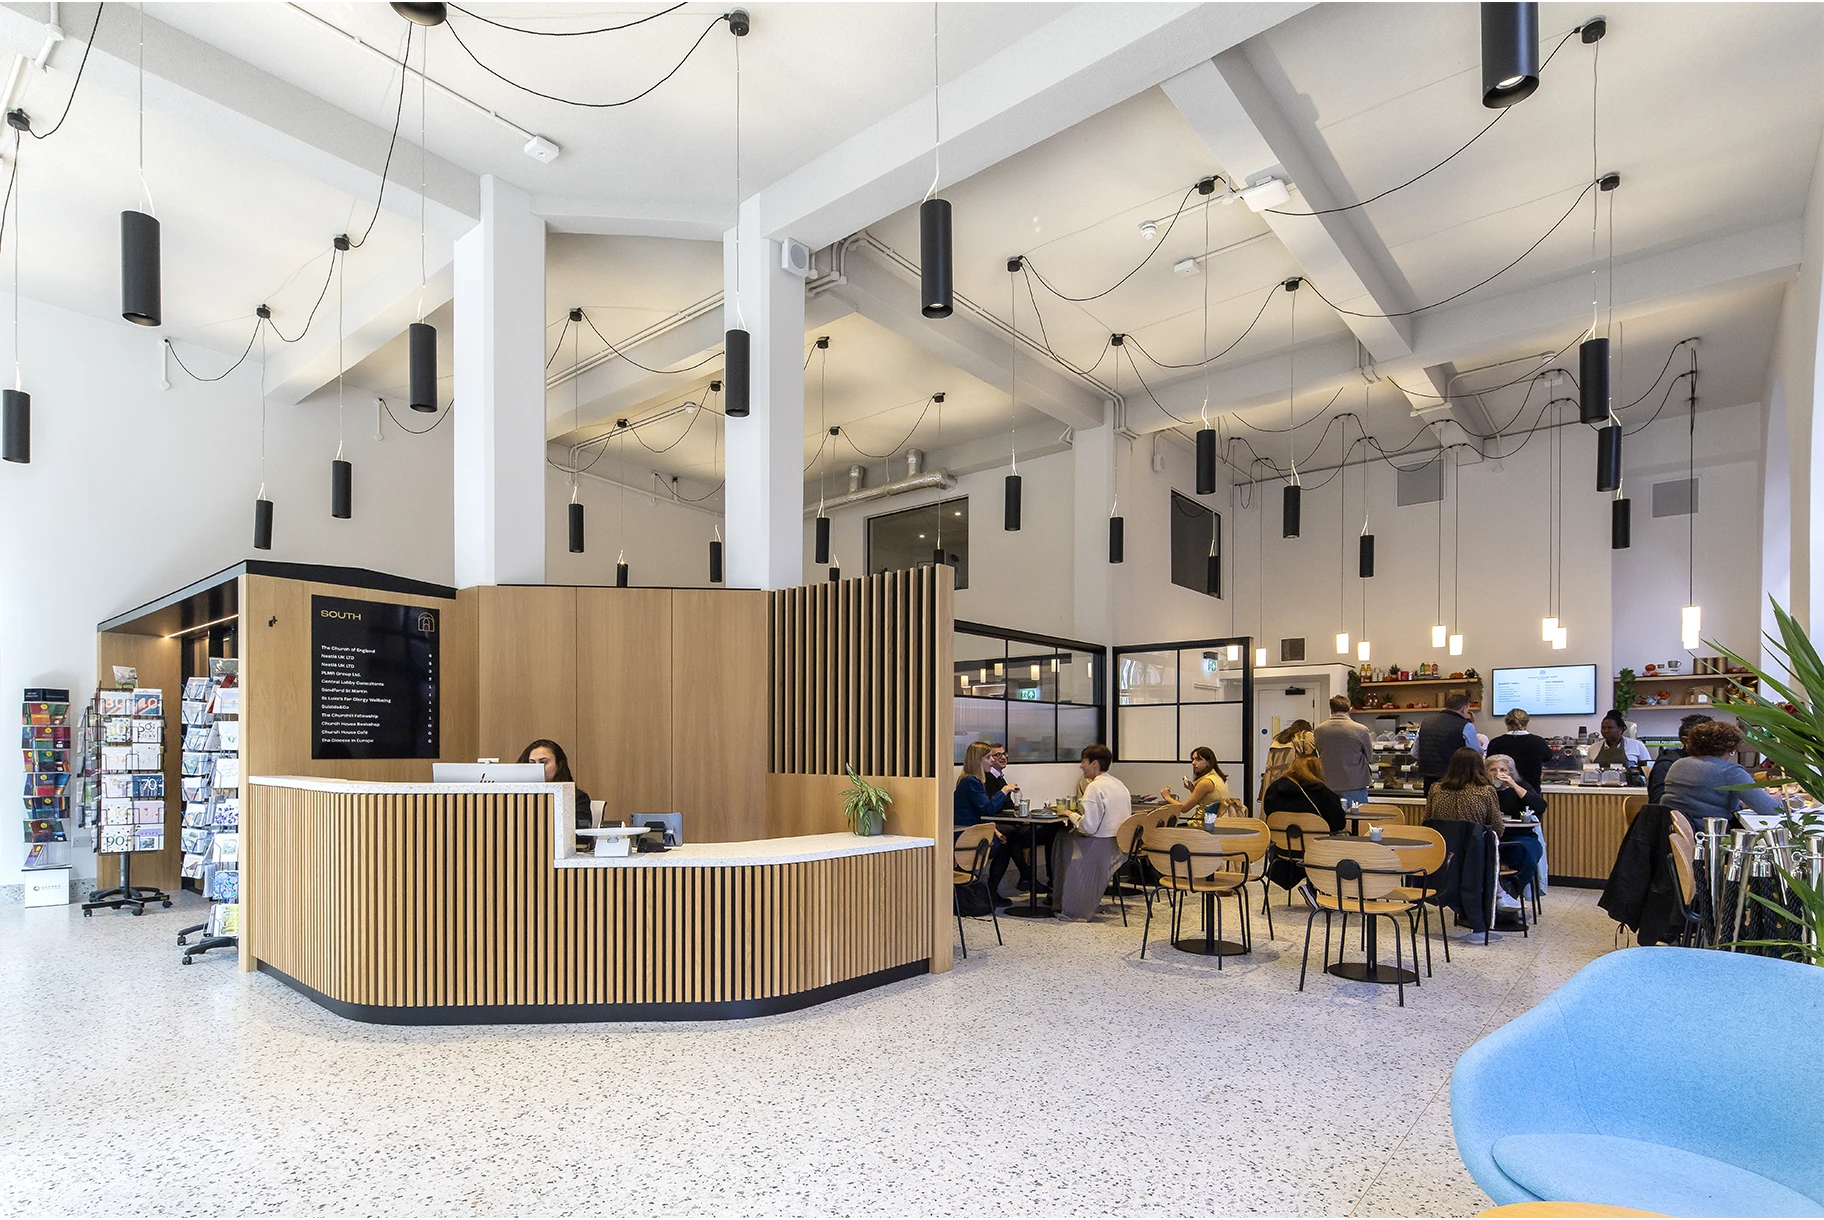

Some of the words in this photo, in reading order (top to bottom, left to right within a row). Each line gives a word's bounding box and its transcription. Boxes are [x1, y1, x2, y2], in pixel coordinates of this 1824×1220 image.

[320, 609, 362, 621] SOUTH
[136, 697, 158, 708] 40
[141, 778, 158, 790] 70
[106, 835, 125, 847] 90
